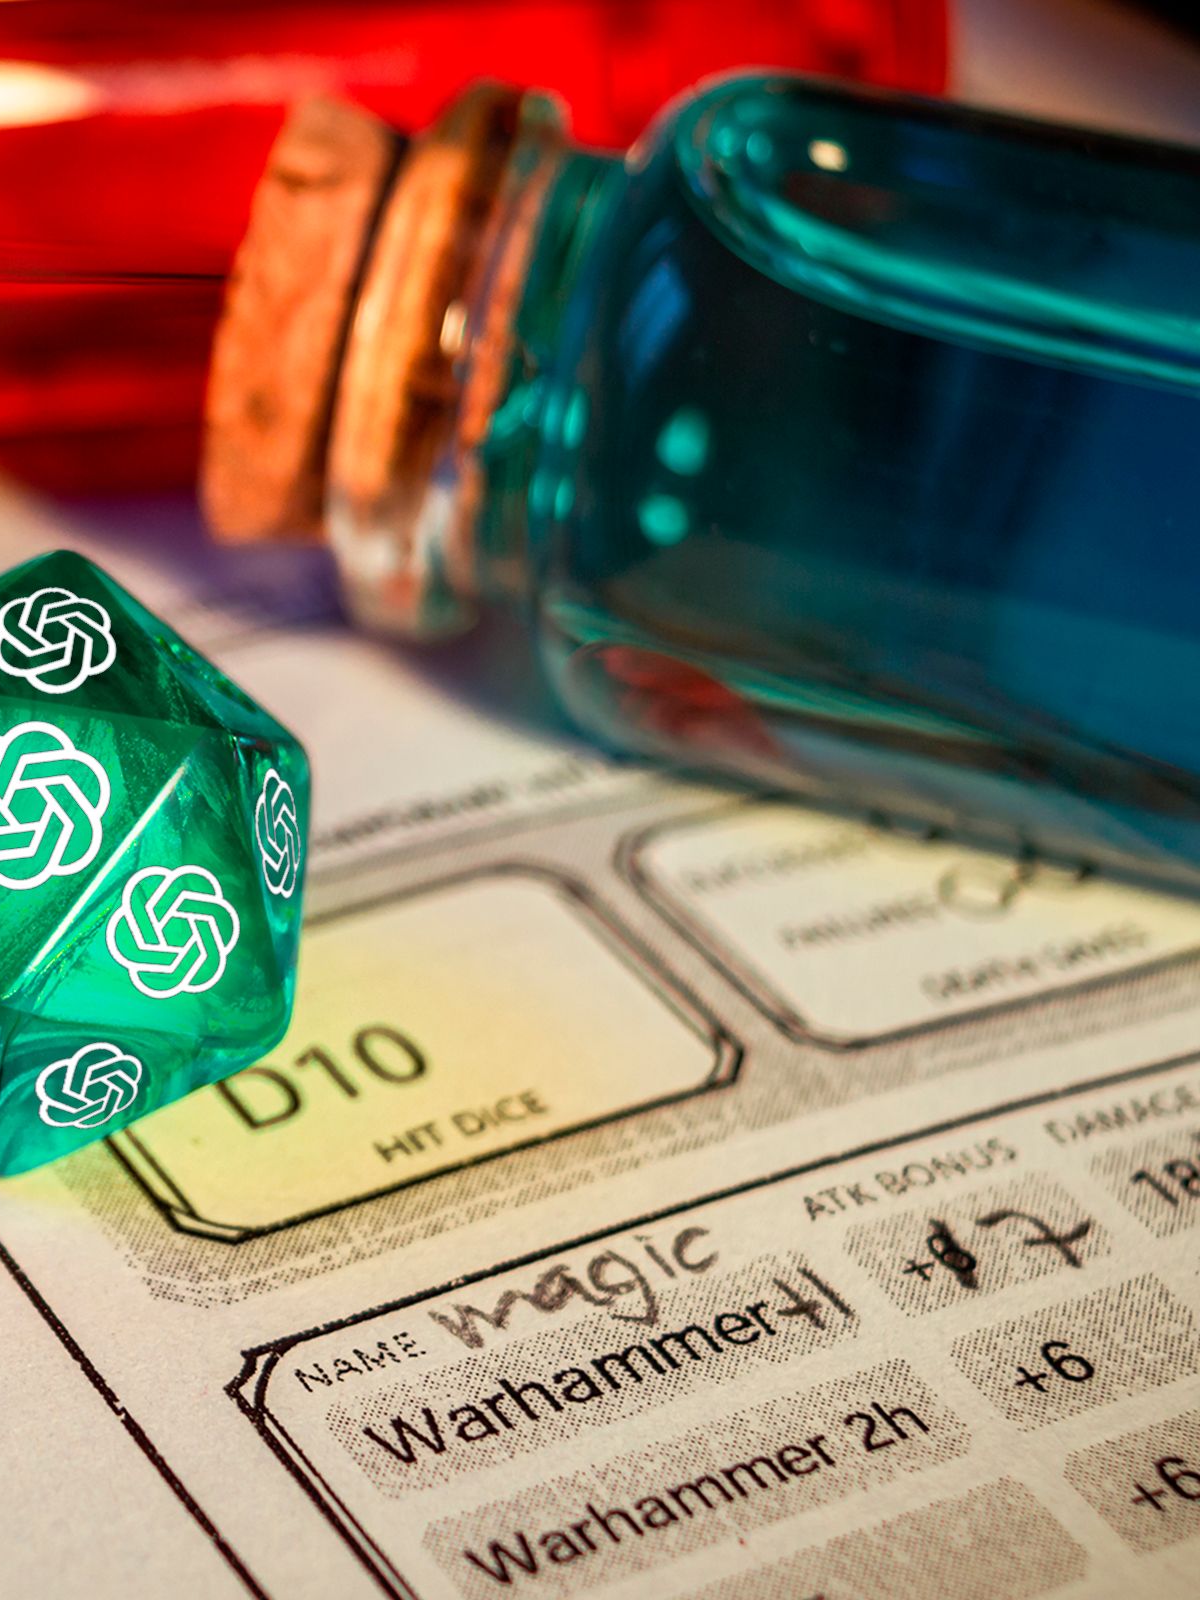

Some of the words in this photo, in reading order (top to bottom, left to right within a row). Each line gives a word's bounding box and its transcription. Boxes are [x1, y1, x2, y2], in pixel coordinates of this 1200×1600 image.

[215, 1026, 428, 1132] D10
[372, 1123, 443, 1162] HIT
[452, 1089, 548, 1137] DICE
[803, 1181, 878, 1222] ATK
[875, 1138, 1018, 1195] BONUS
[293, 1332, 427, 1392] NAME
[363, 1298, 777, 1465] Warhammer
[1014, 1340, 1095, 1394] +6
[464, 1434, 836, 1585] Warhammer
[843, 1401, 930, 1453] 2h
[1130, 1455, 1200, 1513] +6
